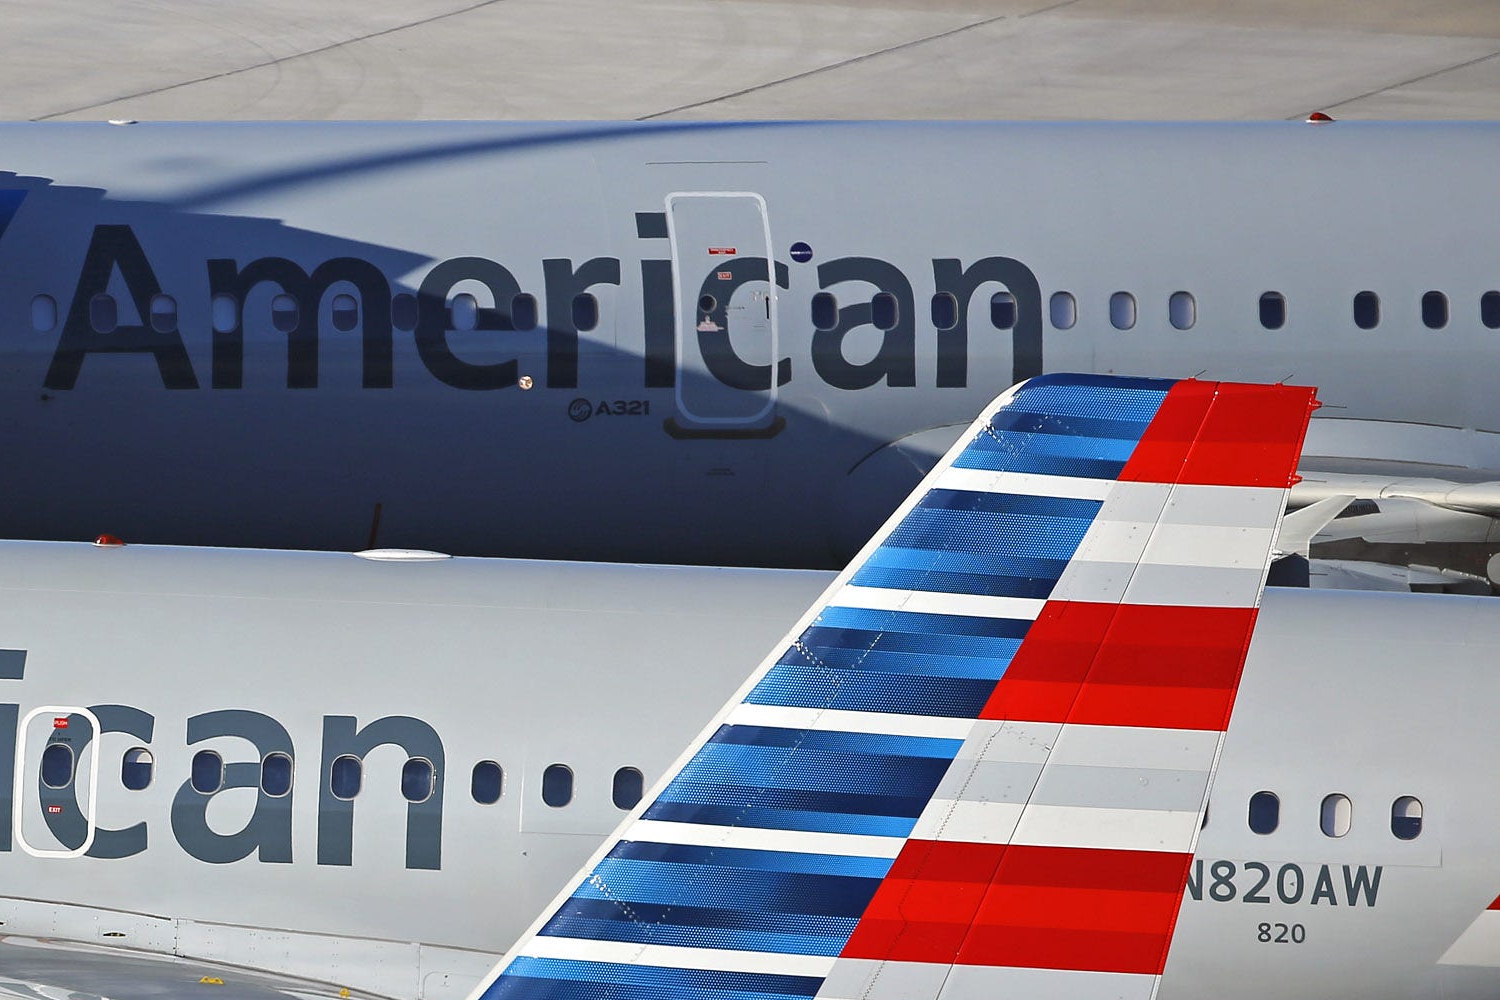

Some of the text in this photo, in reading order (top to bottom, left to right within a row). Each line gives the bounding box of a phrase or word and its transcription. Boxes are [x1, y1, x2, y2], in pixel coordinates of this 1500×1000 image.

[42, 213, 1043, 391] American
[595, 401, 650, 416] A321
[1187, 859, 1383, 907] N820AW
[1257, 923, 1306, 943] 820
